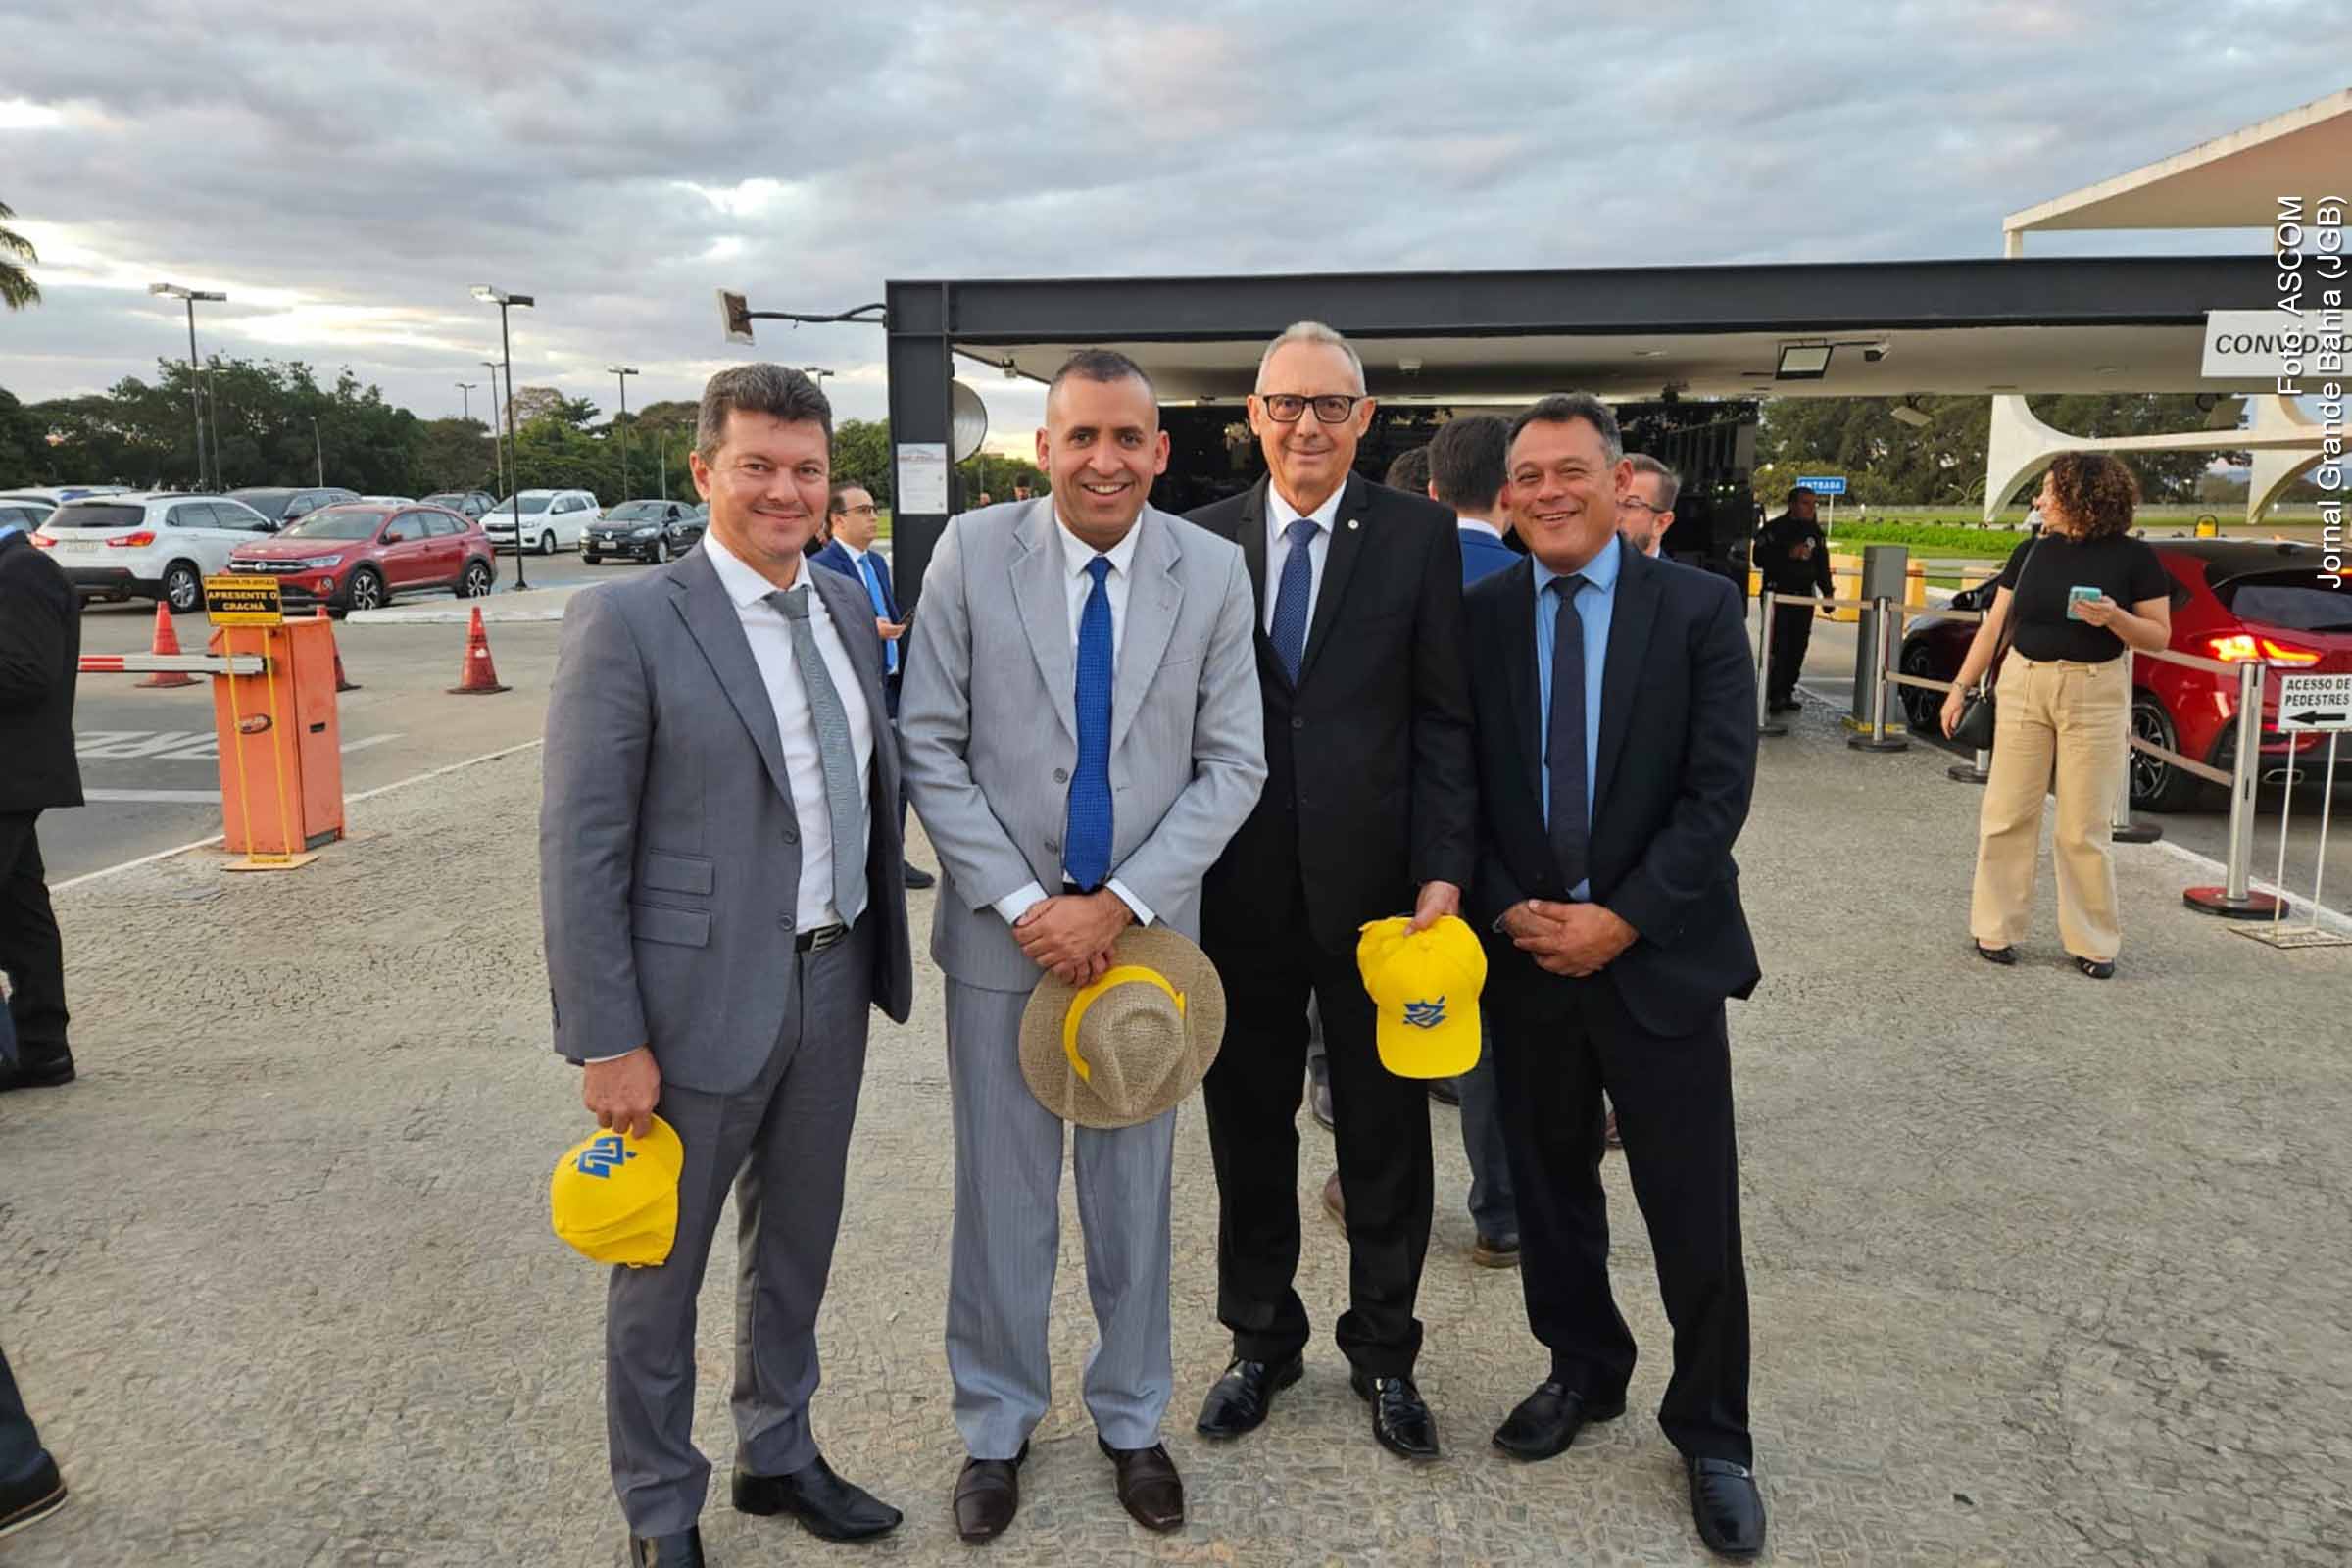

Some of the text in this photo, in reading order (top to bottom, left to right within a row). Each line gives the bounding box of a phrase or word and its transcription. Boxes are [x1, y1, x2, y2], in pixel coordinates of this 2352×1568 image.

[208, 591, 267, 600] APRESENTE
[2287, 678, 2351, 690] ACESSO DE
[2285, 694, 2350, 706] PEDESTRES
